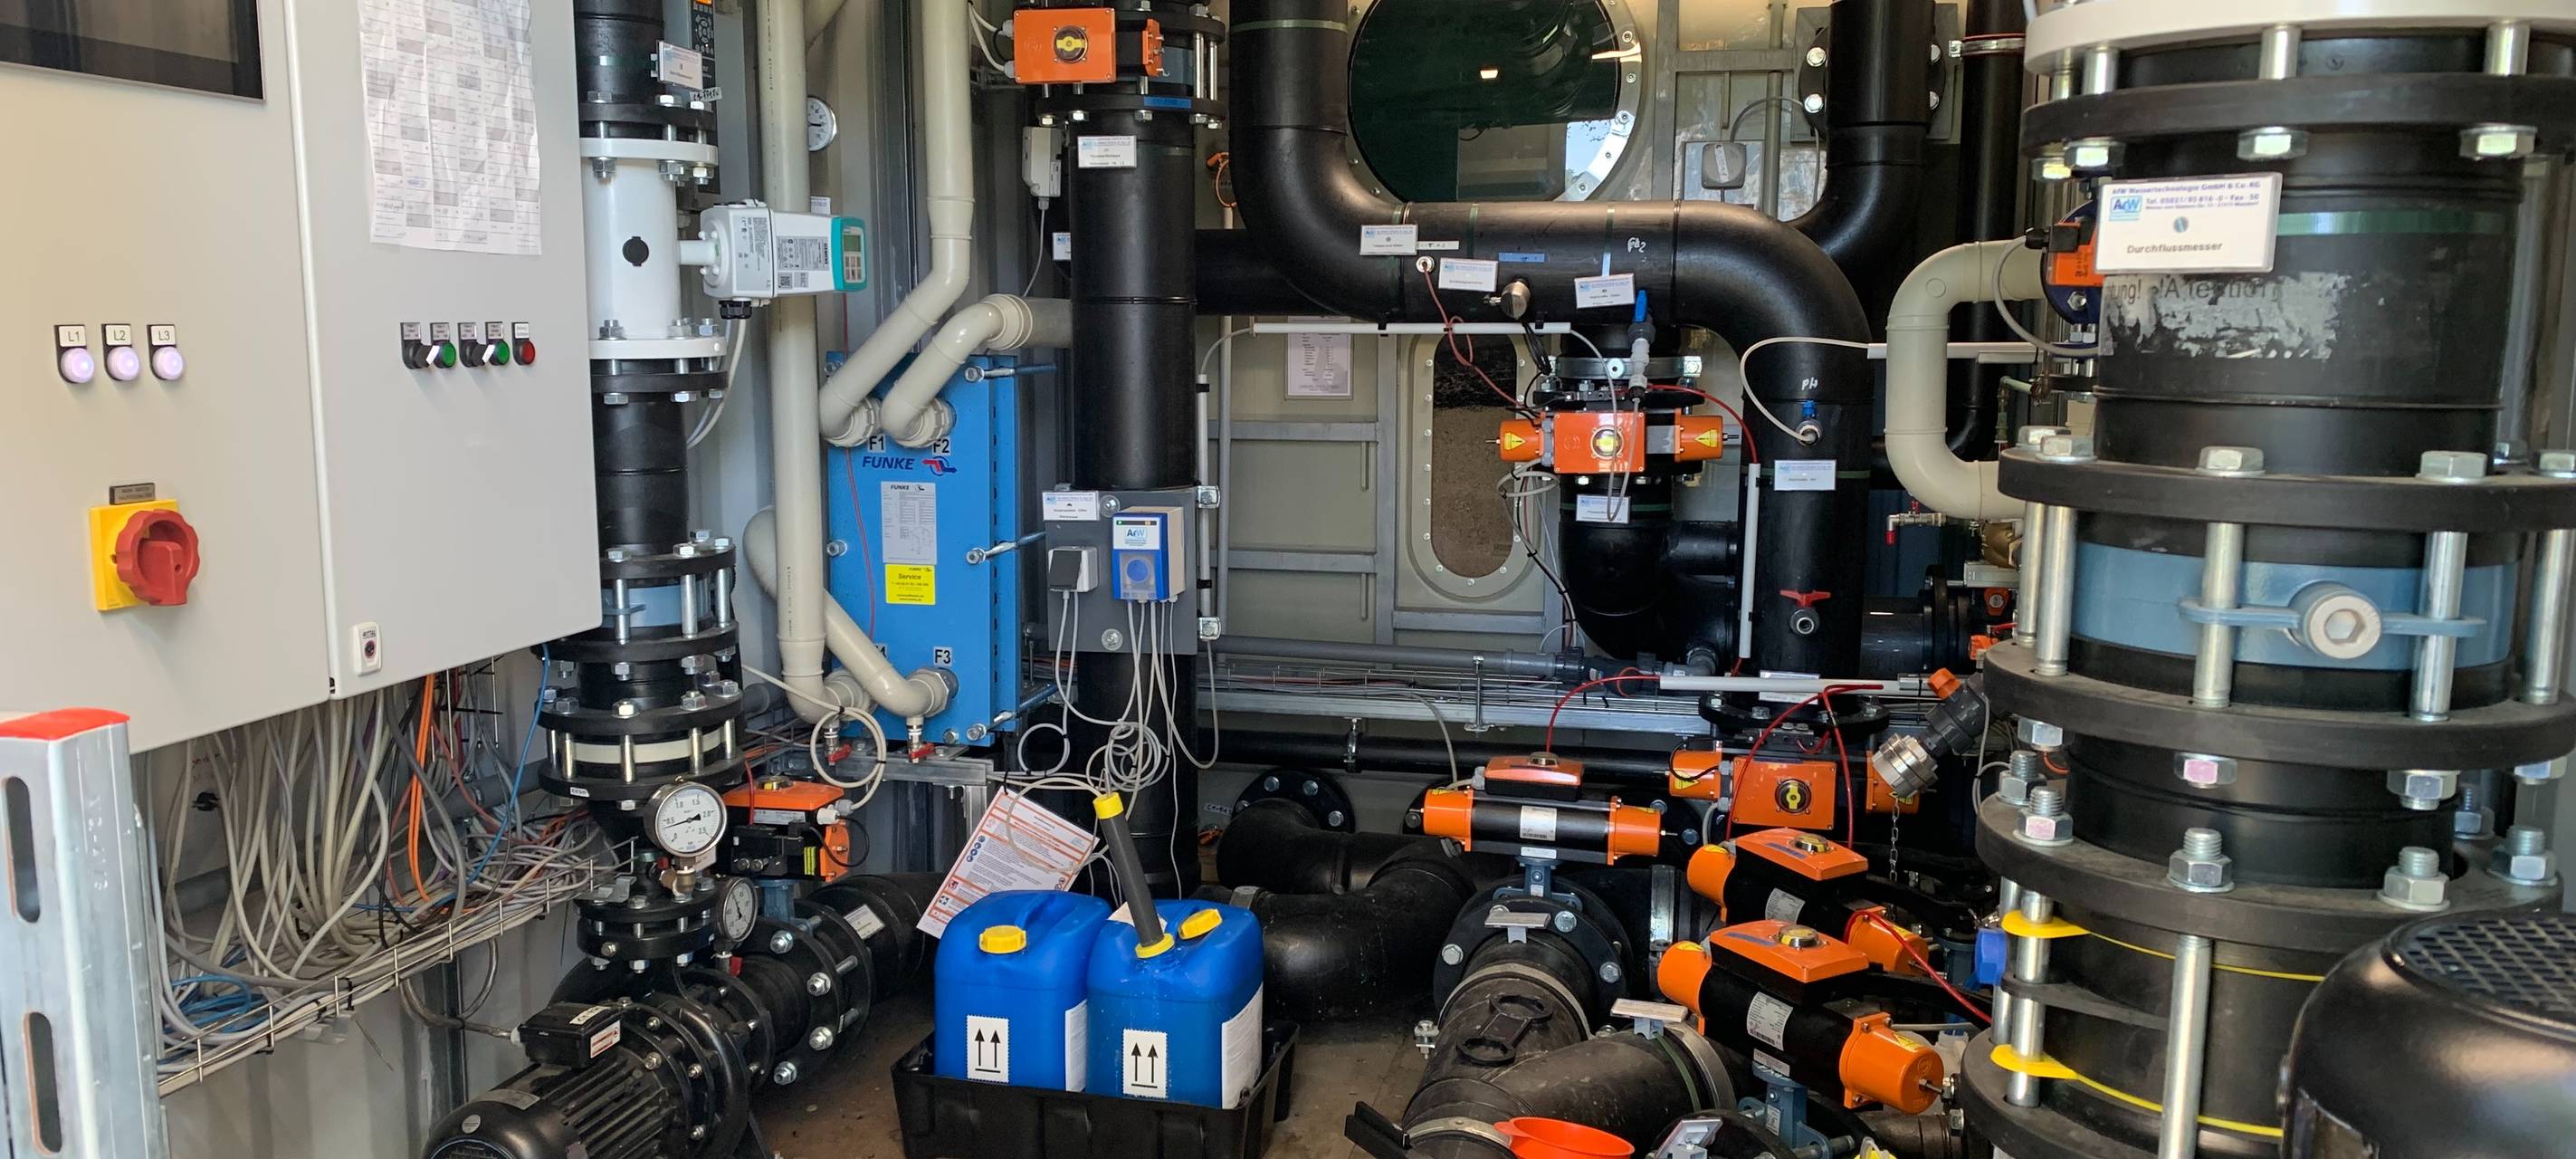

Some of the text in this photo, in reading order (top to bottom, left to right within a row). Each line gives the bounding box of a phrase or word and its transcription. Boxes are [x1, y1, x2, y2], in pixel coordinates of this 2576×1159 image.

[2127, 243, 2223, 254] Durchflussmesser
[68, 331, 81, 341] L1
[113, 330, 126, 340] L2
[157, 330, 170, 340] L3
[869, 436, 884, 450] F1
[933, 439, 949, 453] F2
[862, 455, 915, 470] FUNKE
[934, 648, 951, 664] F3
